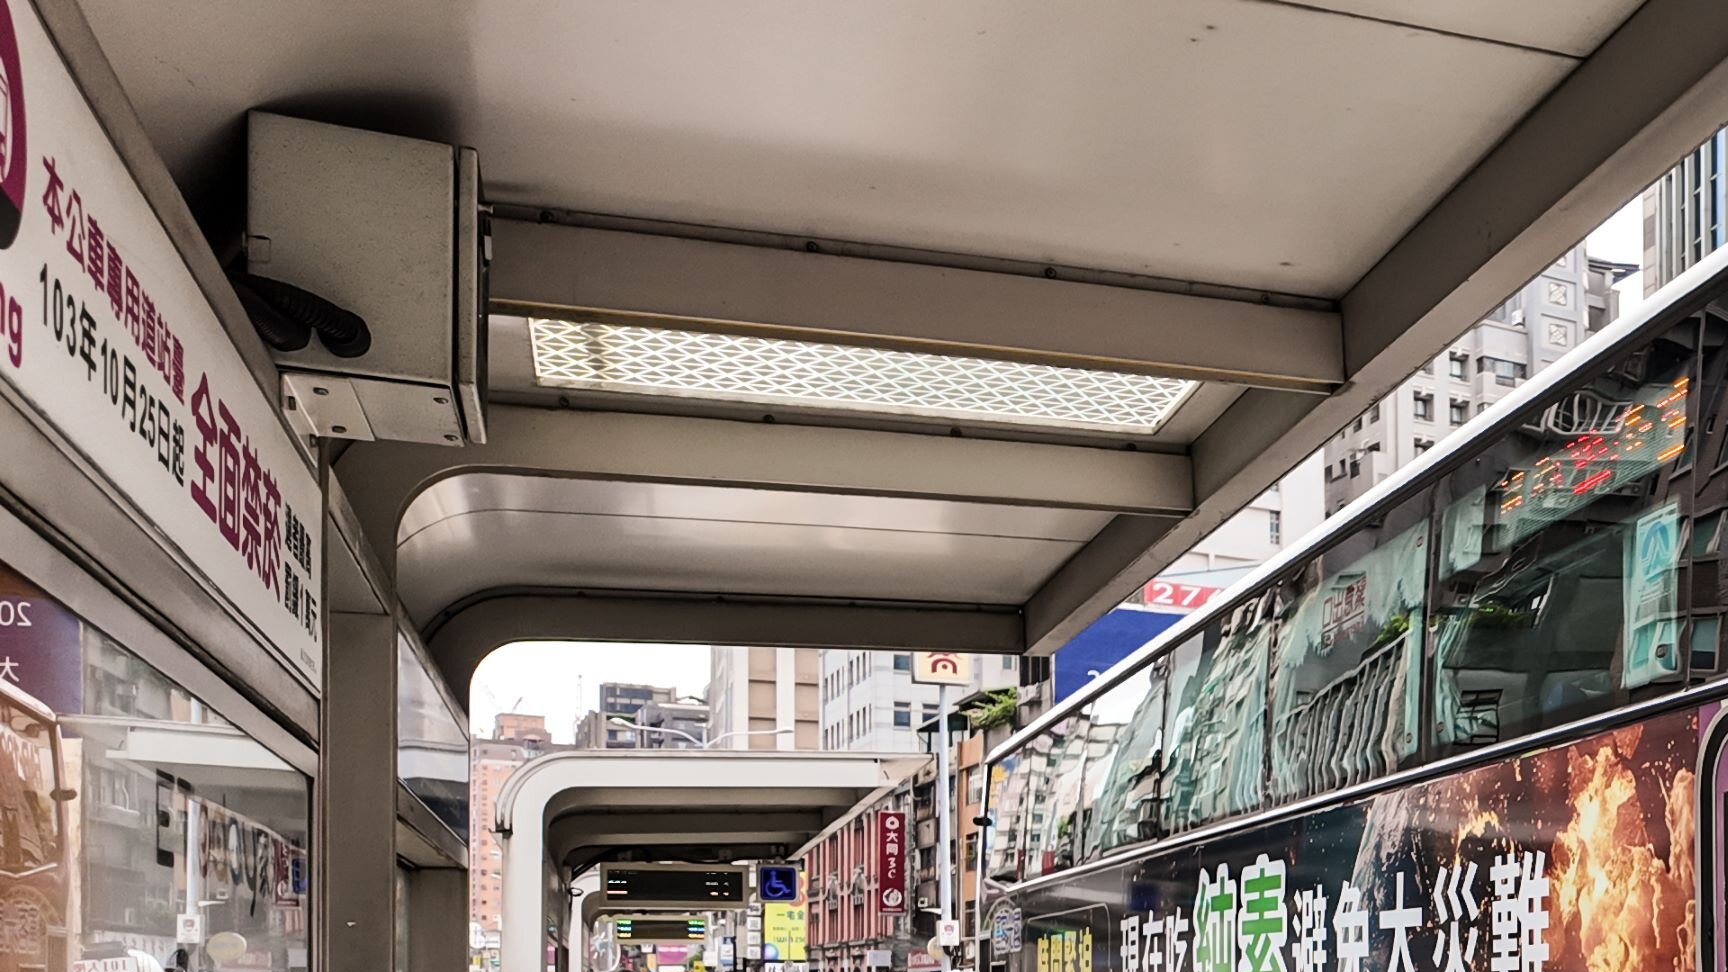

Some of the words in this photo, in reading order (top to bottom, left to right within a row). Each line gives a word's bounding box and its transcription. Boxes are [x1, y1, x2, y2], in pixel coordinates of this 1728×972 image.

[39, 262, 184, 487] 103年10月25日起
[43, 155, 185, 406] 本公車專用道站臺
[190, 372, 281, 602] 全面禁菸
[1152, 583, 1222, 605] 27
